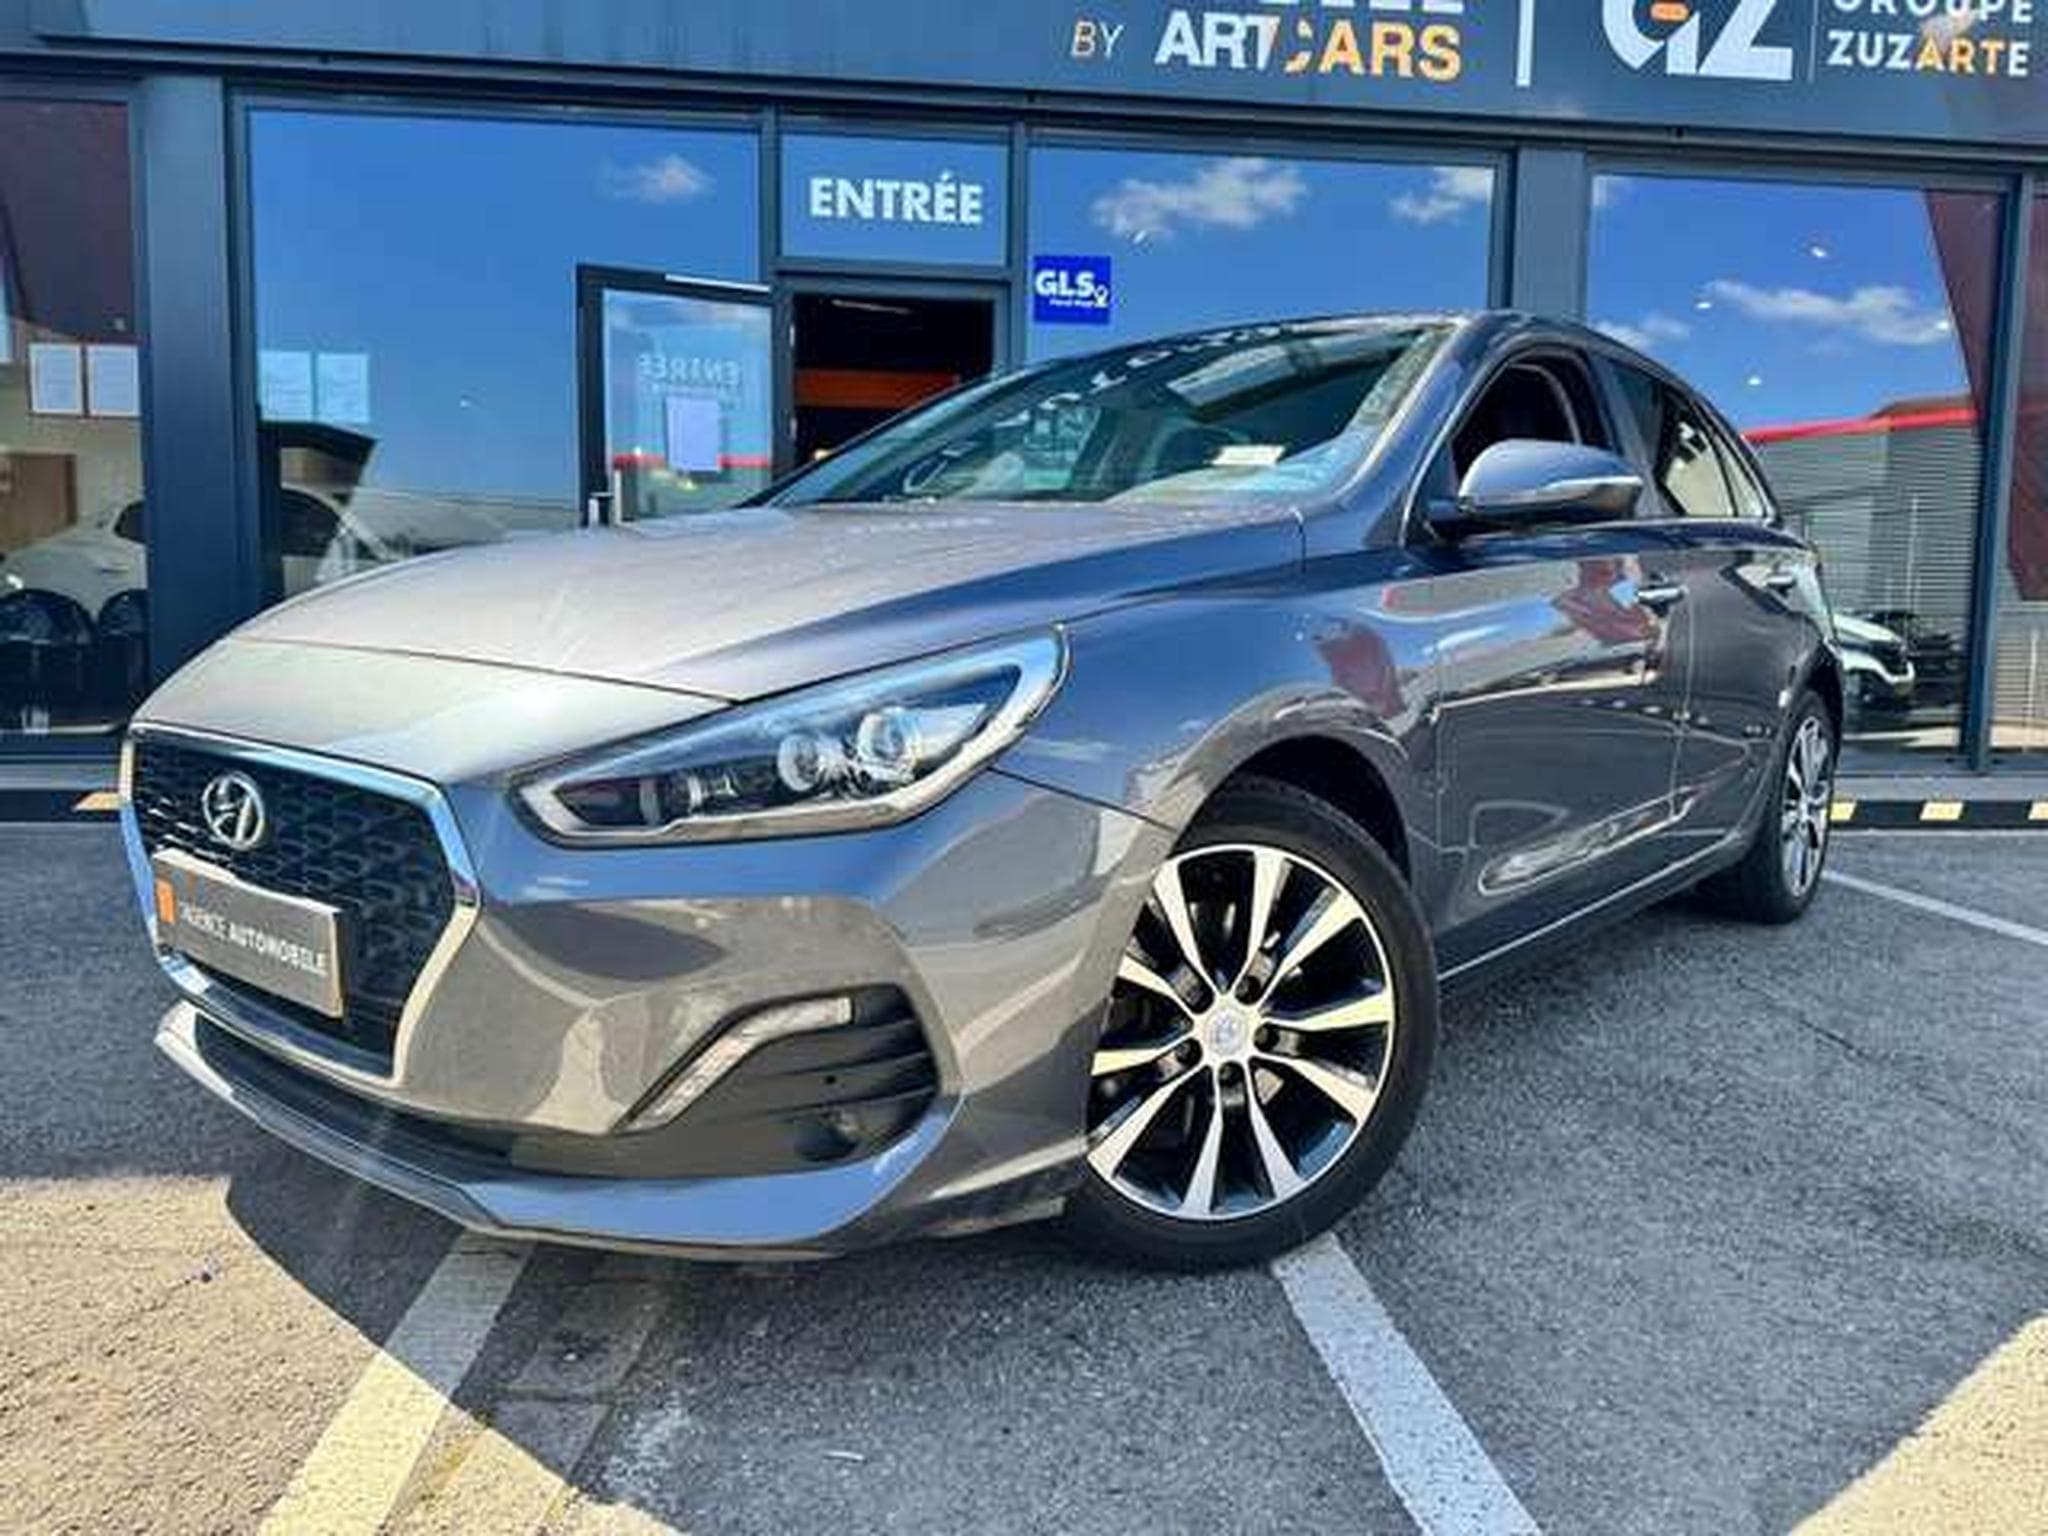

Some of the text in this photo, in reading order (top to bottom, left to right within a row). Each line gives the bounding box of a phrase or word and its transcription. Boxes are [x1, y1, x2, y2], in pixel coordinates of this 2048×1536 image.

[1070, 20, 1124, 58] BY
[1827, 29, 2031, 77] ZUZARTE
[810, 171, 983, 224] ENTRÉE
[1036, 269, 1095, 298] GLS
